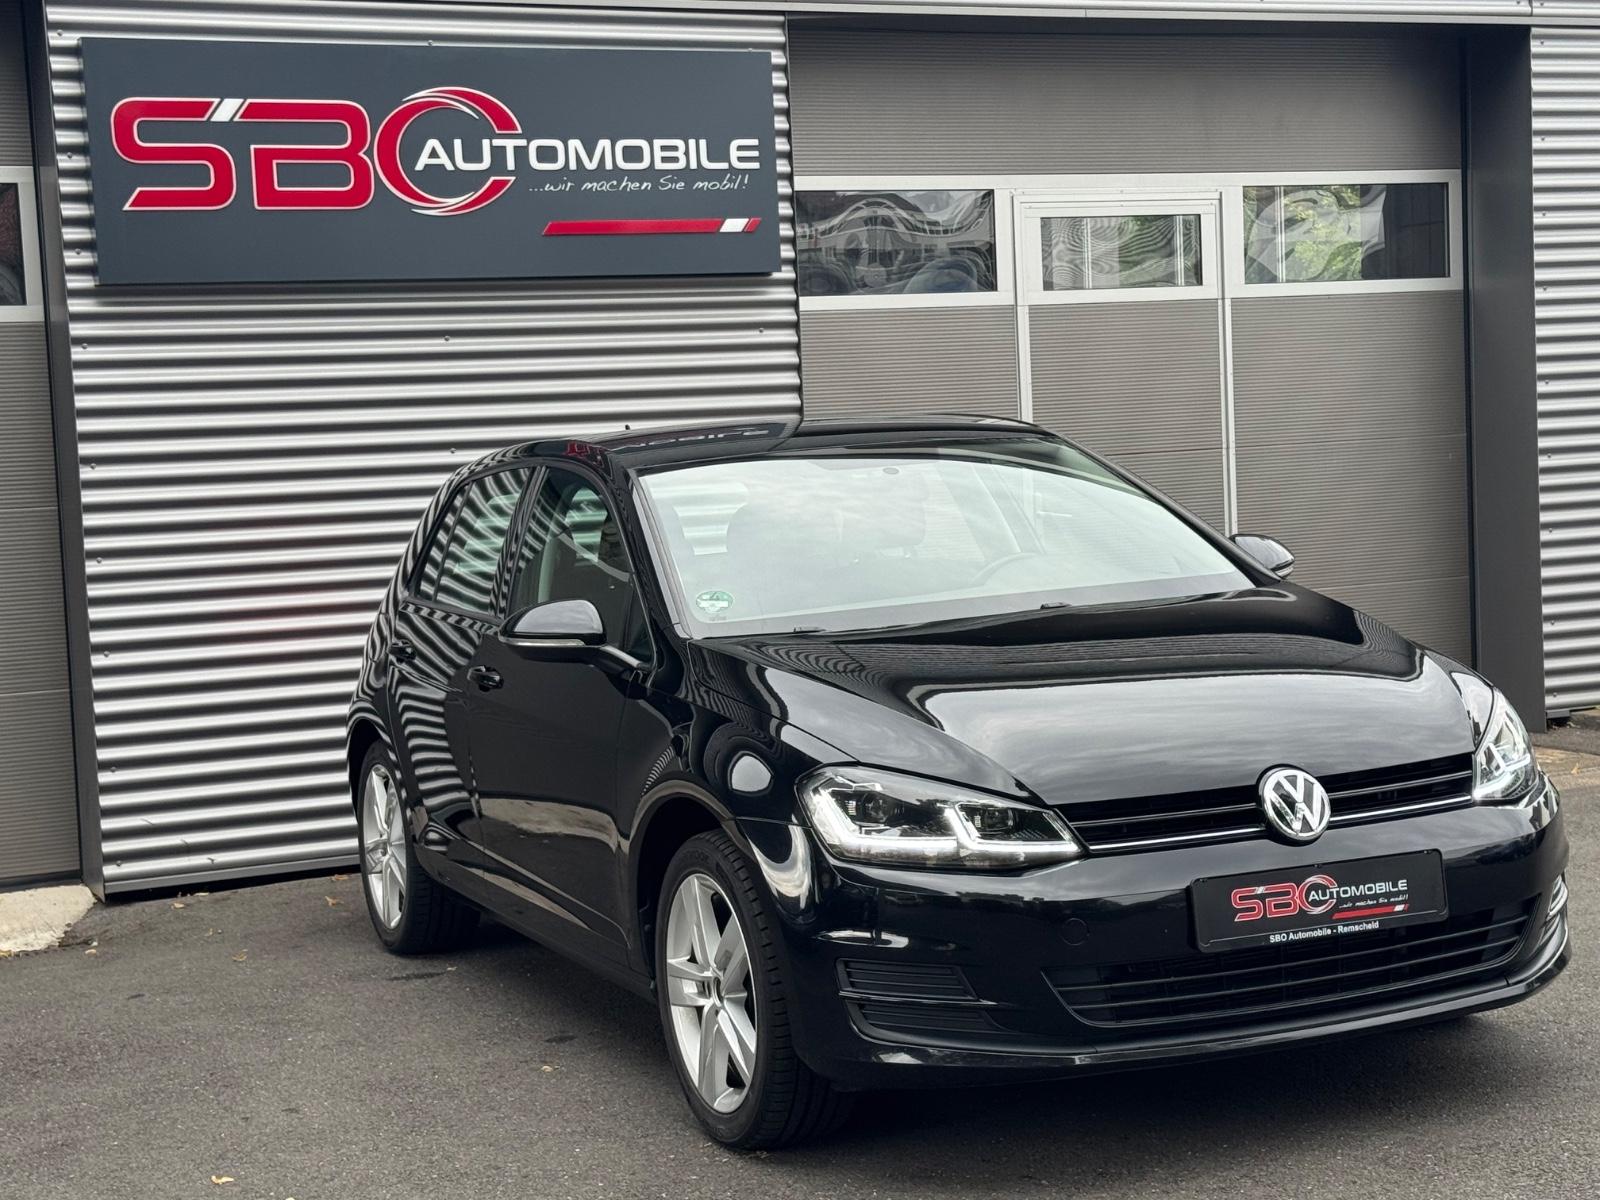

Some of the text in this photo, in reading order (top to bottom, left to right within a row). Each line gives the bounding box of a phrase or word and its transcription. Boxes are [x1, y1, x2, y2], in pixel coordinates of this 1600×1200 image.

[414, 138, 761, 171] AUTOMOBILE
[580, 176, 652, 192] machen
[658, 174, 686, 191] Sie
[692, 173, 750, 191] mobil!
[1308, 880, 1408, 902] AUTOMOBILE
[1269, 933, 1287, 943] SBO
[1288, 927, 1332, 940] Automobile
[1337, 921, 1380, 934] Remscheid
